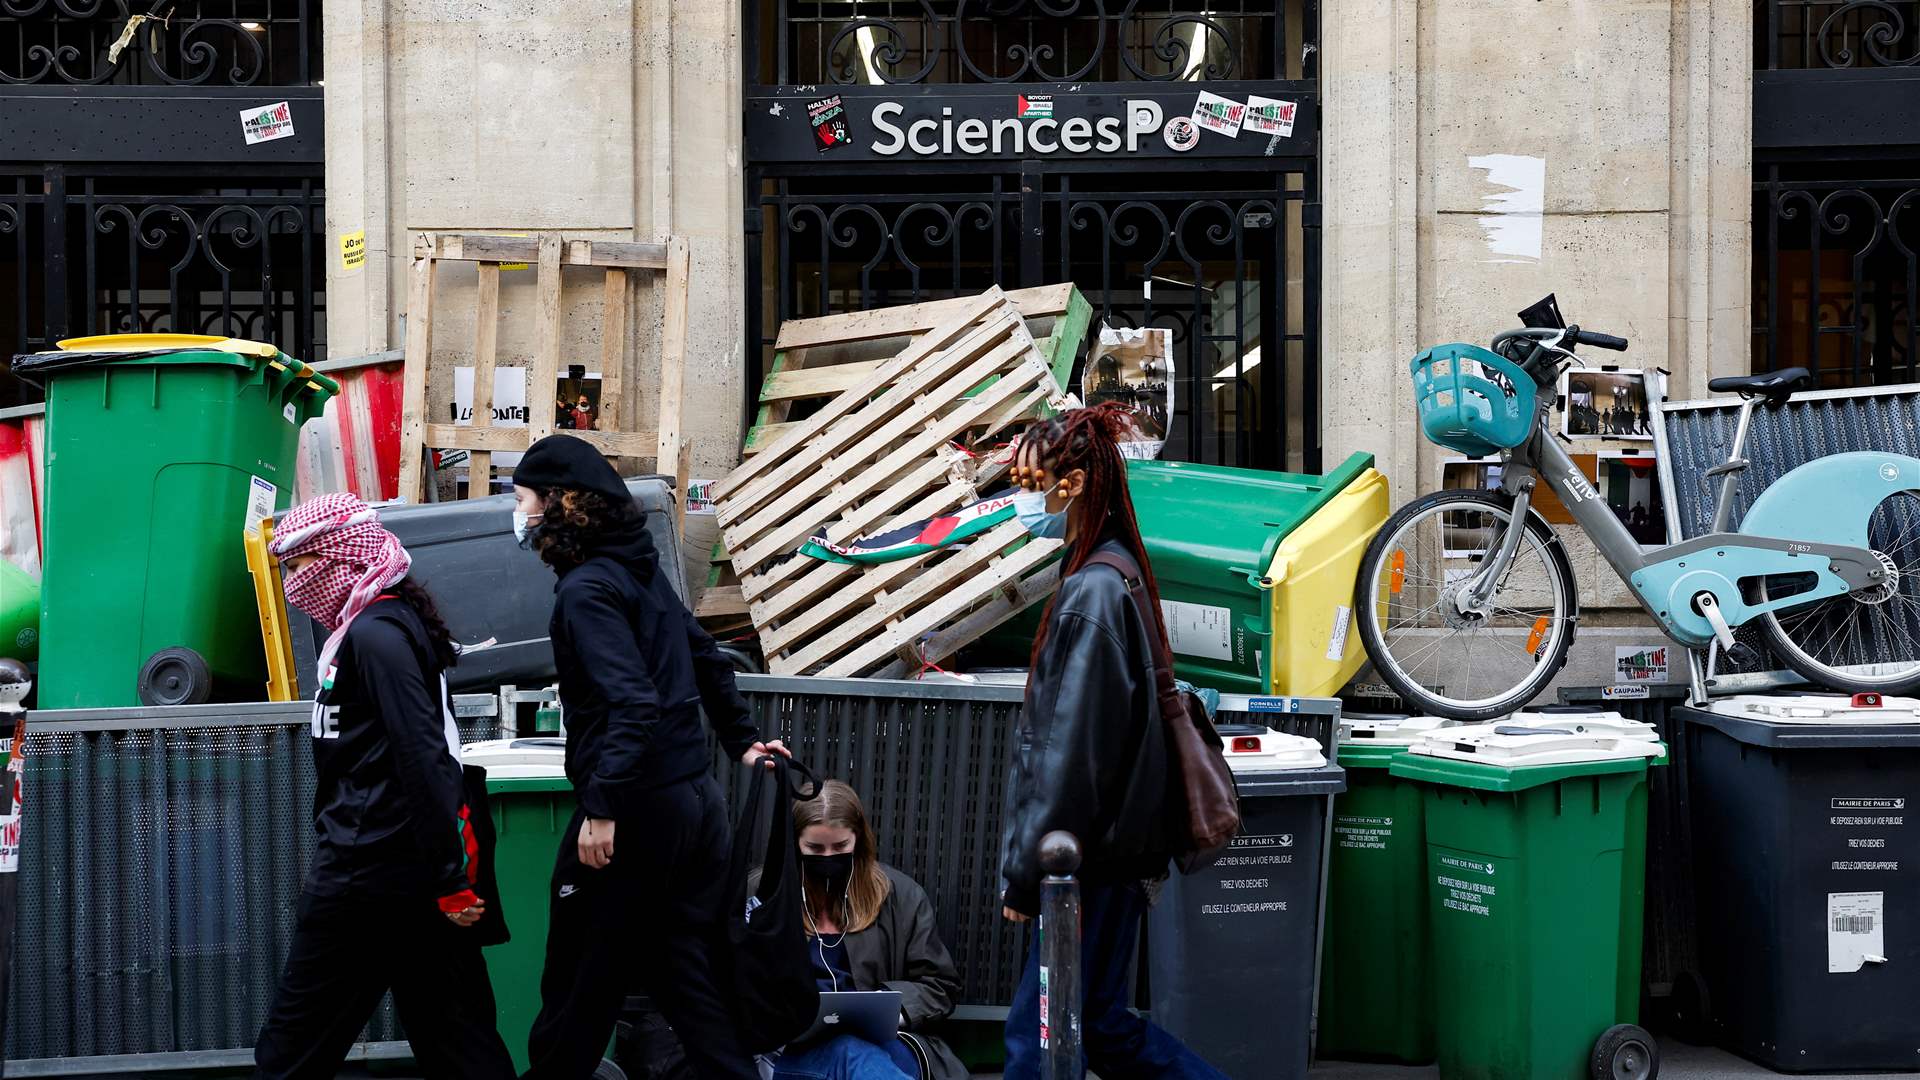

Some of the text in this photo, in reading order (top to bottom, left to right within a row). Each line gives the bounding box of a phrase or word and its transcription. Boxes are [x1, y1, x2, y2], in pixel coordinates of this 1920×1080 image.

[808, 98, 832, 110] HALTE
[245, 104, 288, 126] PALESTINE
[871, 101, 1163, 155] SciencesP
[345, 239, 354, 248] JO
[492, 406, 523, 420] ONTE
[1789, 544, 1811, 552] 71857
[1618, 648, 1666, 666] PALESTINE
[1848, 839, 1858, 848] TRIEZ
[1859, 839, 1867, 848] VOS
[1227, 857, 1239, 865] RIEN
[1239, 856, 1250, 865] SUR
[1250, 856, 1256, 864] LA
[1256, 856, 1268, 864] VOIE
[1268, 855, 1292, 864] PUBLIQUE
[1442, 857, 1459, 866] MAIRIE
[1468, 862, 1483, 870] PARIS
[1832, 861, 1848, 870] UTILISEZ
[1848, 861, 1853, 870] LE
[1853, 861, 1876, 870] CONTENEUR
[1220, 880, 1234, 888] TRIEZ
[1235, 880, 1245, 888] VOS
[1480, 884, 1495, 895] PUBLIQUE
[1202, 904, 1223, 914] UTILISEZ
[1223, 904, 1229, 913] LE
[1230, 903, 1260, 912] CONTENEUR
